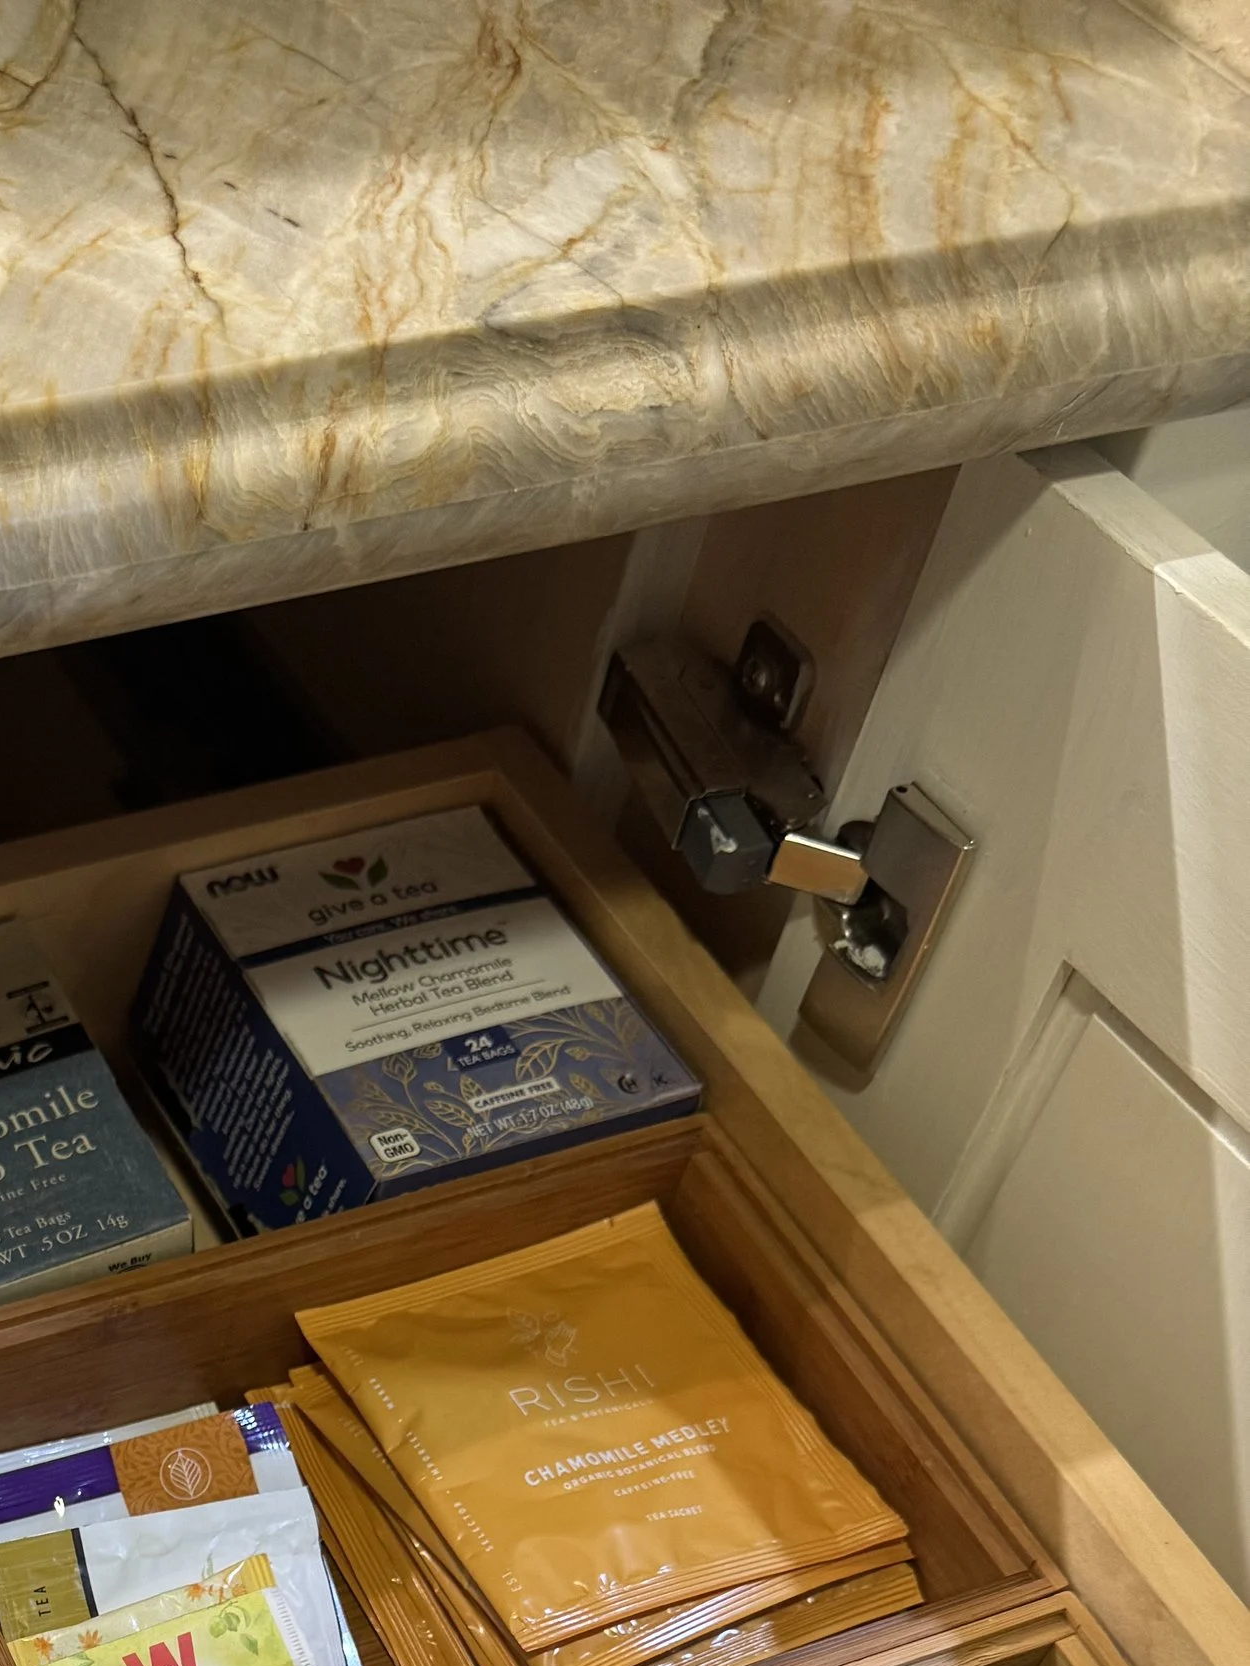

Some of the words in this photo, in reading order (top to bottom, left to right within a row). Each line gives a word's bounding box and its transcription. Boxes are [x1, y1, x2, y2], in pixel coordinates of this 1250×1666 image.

[308, 895, 365, 926] give
[372, 887, 388, 906] a
[393, 879, 439, 901] tea
[313, 925, 508, 991] Nighttime
[457, 1053, 481, 1068] TEA
[483, 1043, 516, 1063] BAGS
[464, 1035, 491, 1054] 24
[14, 1130, 97, 1170] Tea
[377, 1132, 408, 1149] Non-
[383, 1142, 416, 1161] GMO
[56, 1224, 89, 1246] OZ
[98, 1212, 129, 1234] 14g
[508, 1364, 655, 1417] RISHI
[523, 1441, 648, 1488] CHAMOMILE
[650, 1417, 731, 1453] MEDLEY
